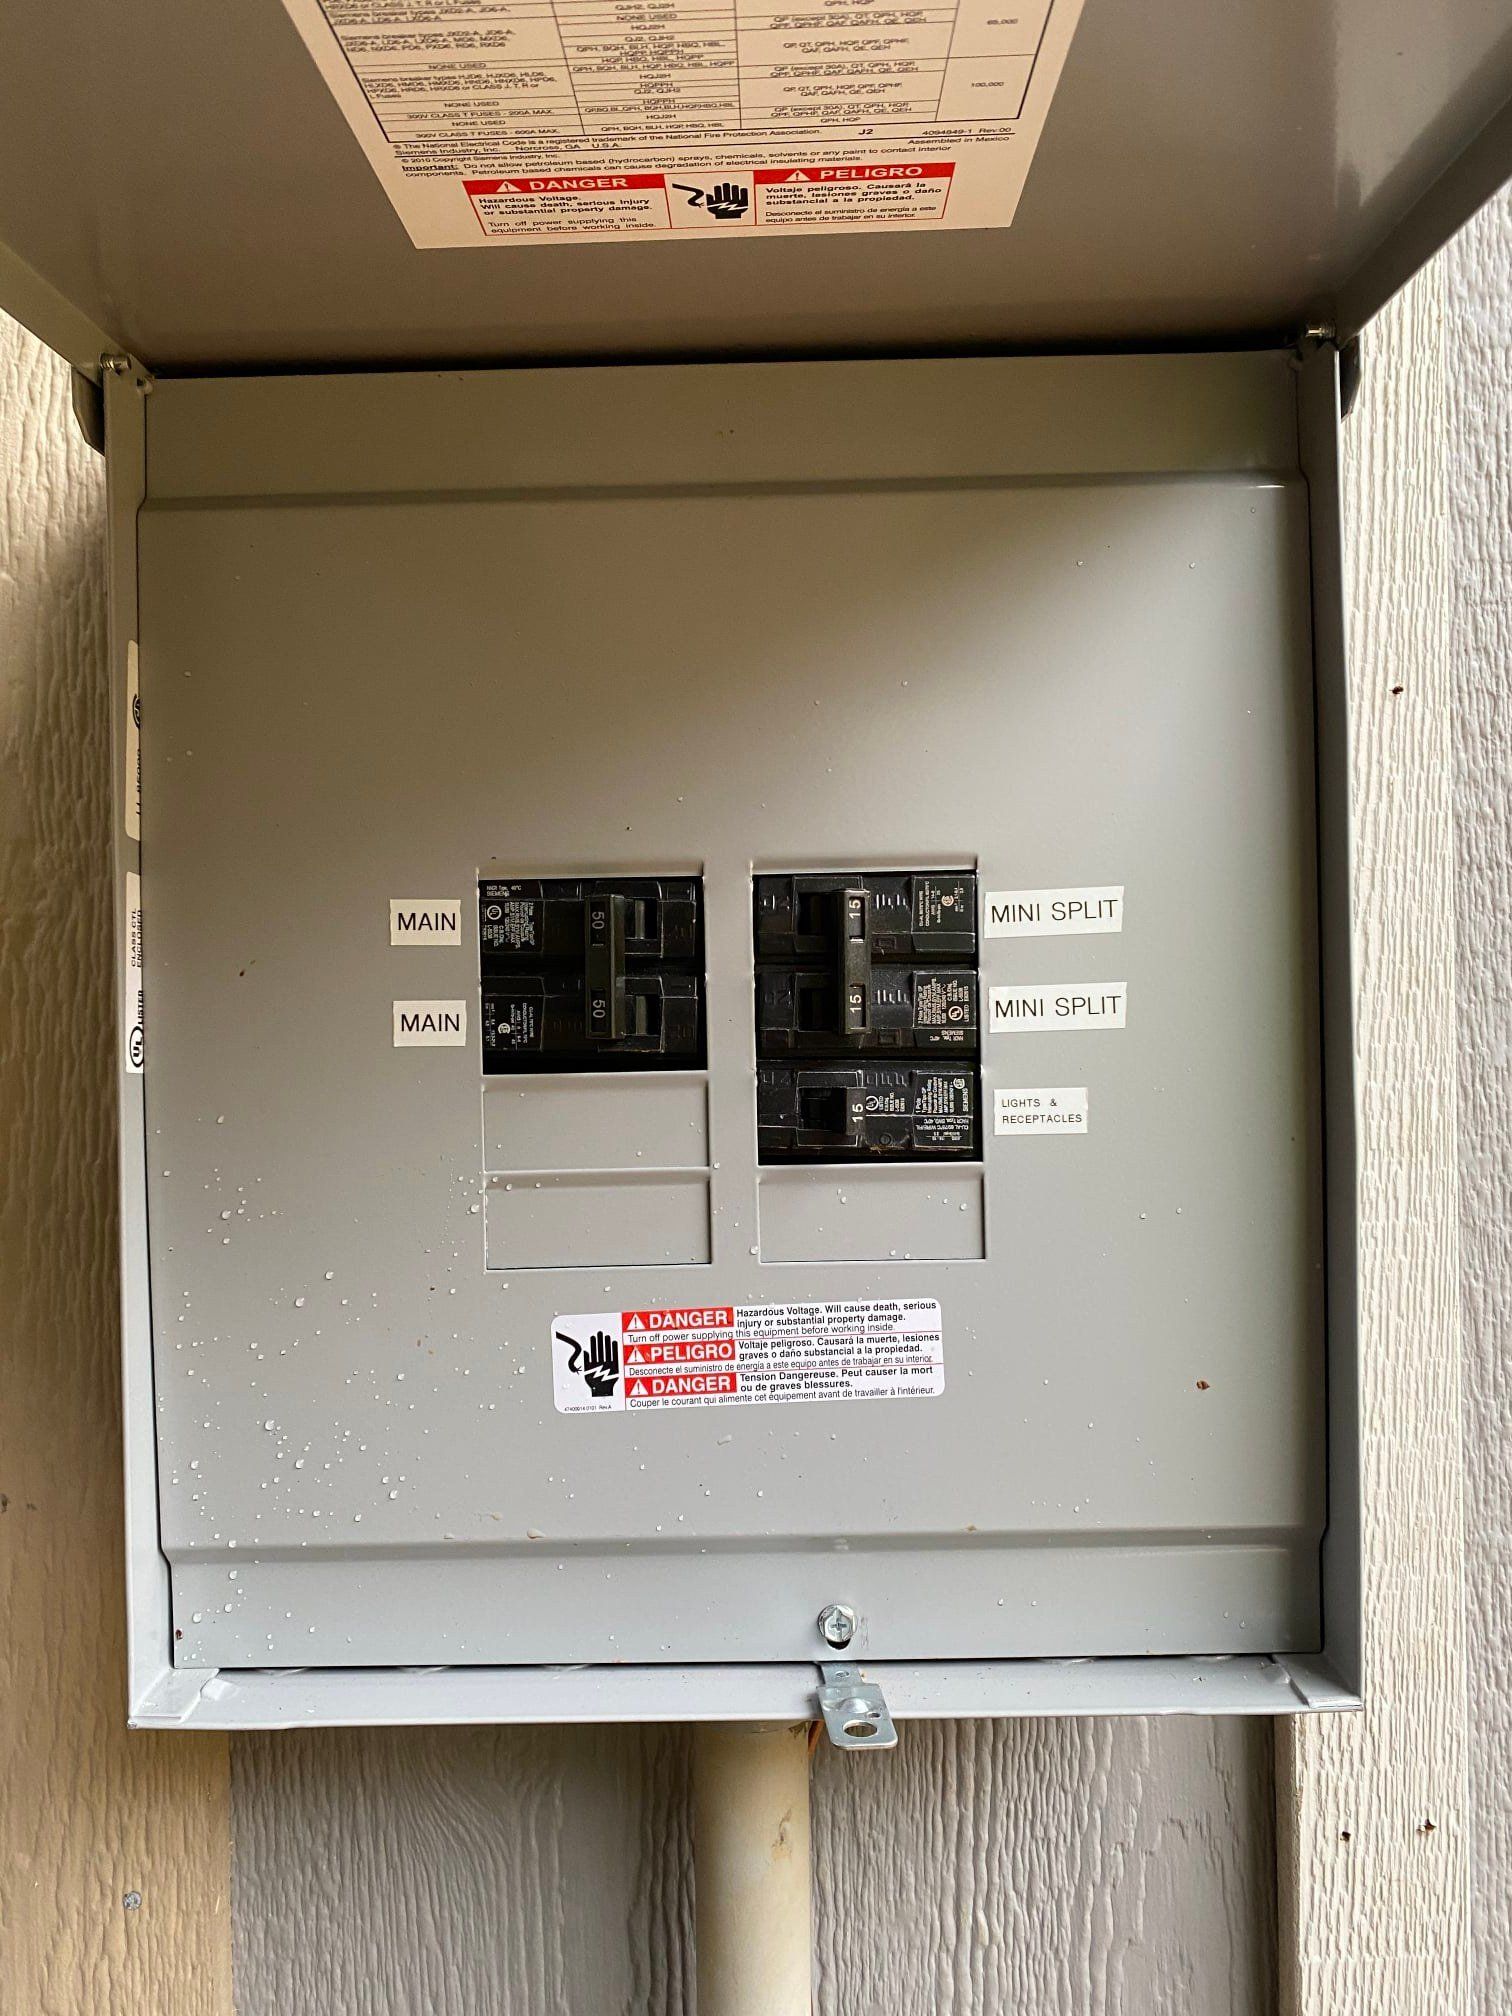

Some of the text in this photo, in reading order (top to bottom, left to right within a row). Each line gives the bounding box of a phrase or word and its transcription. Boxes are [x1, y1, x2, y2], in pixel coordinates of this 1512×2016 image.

[402, 163, 458, 172] Important:
[820, 166, 923, 180] PELIGRO
[529, 178, 628, 191] DANGER
[766, 186, 802, 194] Voltaje
[807, 184, 861, 193] peligroso.
[866, 182, 911, 190] Causará
[478, 194, 580, 204] Hazardous Voltage.
[766, 192, 806, 200] muerte,
[766, 197, 827, 205] substancial
[857, 194, 915, 204] propiedad.
[499, 207, 556, 215] substantial
[560, 206, 604, 214] property
[608, 204, 653, 213] damage.
[540, 201, 572, 209] death,
[491, 226, 541, 234] equipment
[583, 223, 620, 231] working
[568, 217, 614, 226] supplying
[850, 900, 861, 919] 15
[991, 903, 1041, 924] MINI
[1051, 899, 1118, 921] SPLIT
[398, 912, 456, 931] MAIN
[592, 911, 606, 930] 50
[592, 999, 607, 1019] 50
[851, 994, 862, 1013] 15
[994, 997, 1044, 1018] MINI
[1054, 994, 1122, 1016] SPLIT
[400, 1013, 460, 1032] MAIN
[1002, 1098, 1058, 1108] LIGHTS &
[852, 1102, 863, 1123] 15
[1002, 1114, 1083, 1124] RECEPTACLES
[736, 1301, 937, 1317] Hazardous Voltage. Will cause death, serious
[650, 1310, 728, 1328] DANGER
[736, 1319, 761, 1329] injury
[776, 1316, 824, 1326] substantial
[827, 1314, 864, 1326] property
[867, 1313, 906, 1324] damage.
[628, 1334, 646, 1343] Turn
[648, 1333, 660, 1342] off
[662, 1334, 688, 1343] power
[735, 1329, 750, 1338] this
[753, 1327, 798, 1339] equipment
[801, 1325, 828, 1335] before
[830, 1324, 865, 1335] working
[867, 1322, 896, 1332] inside.
[738, 1333, 940, 1351] Voltaje peligroso. Causará la muerte, lesiones
[652, 1342, 732, 1362] PELIGRO
[739, 1352, 768, 1361] graves
[779, 1349, 801, 1357] daño
[804, 1347, 854, 1356] substancial
[864, 1346, 872, 1354] la
[875, 1344, 922, 1355] propiedad.
[629, 1365, 673, 1376] Desconecte
[675, 1365, 682, 1373] el
[684, 1362, 722, 1373] suministro
[724, 1362, 734, 1371] de
[736, 1360, 764, 1372] energía
[772, 1359, 788, 1368] este
[790, 1358, 816, 1369] equipo
[818, 1357, 839, 1366] antes
[841, 1356, 850, 1365] de
[852, 1355, 881, 1367] trabajar
[740, 1372, 776, 1382] Tension
[779, 1370, 838, 1382] Dangereuse.
[841, 1369, 862, 1378] Peut
[899, 1367, 908, 1375] la
[911, 1366, 934, 1375] mort
[652, 1376, 730, 1394] DANGER
[755, 1383, 766, 1391] de
[769, 1383, 801, 1392] graves
[804, 1380, 853, 1389] blessures.
[630, 1398, 659, 1410] Couper
[661, 1397, 669, 1406] le
[671, 1395, 701, 1405] courant
[703, 1395, 716, 1406] qui
[718, 1393, 752, 1403] alimente
[754, 1392, 766, 1401] cet
[818, 1389, 840, 1398] avant
[842, 1388, 852, 1397] de
